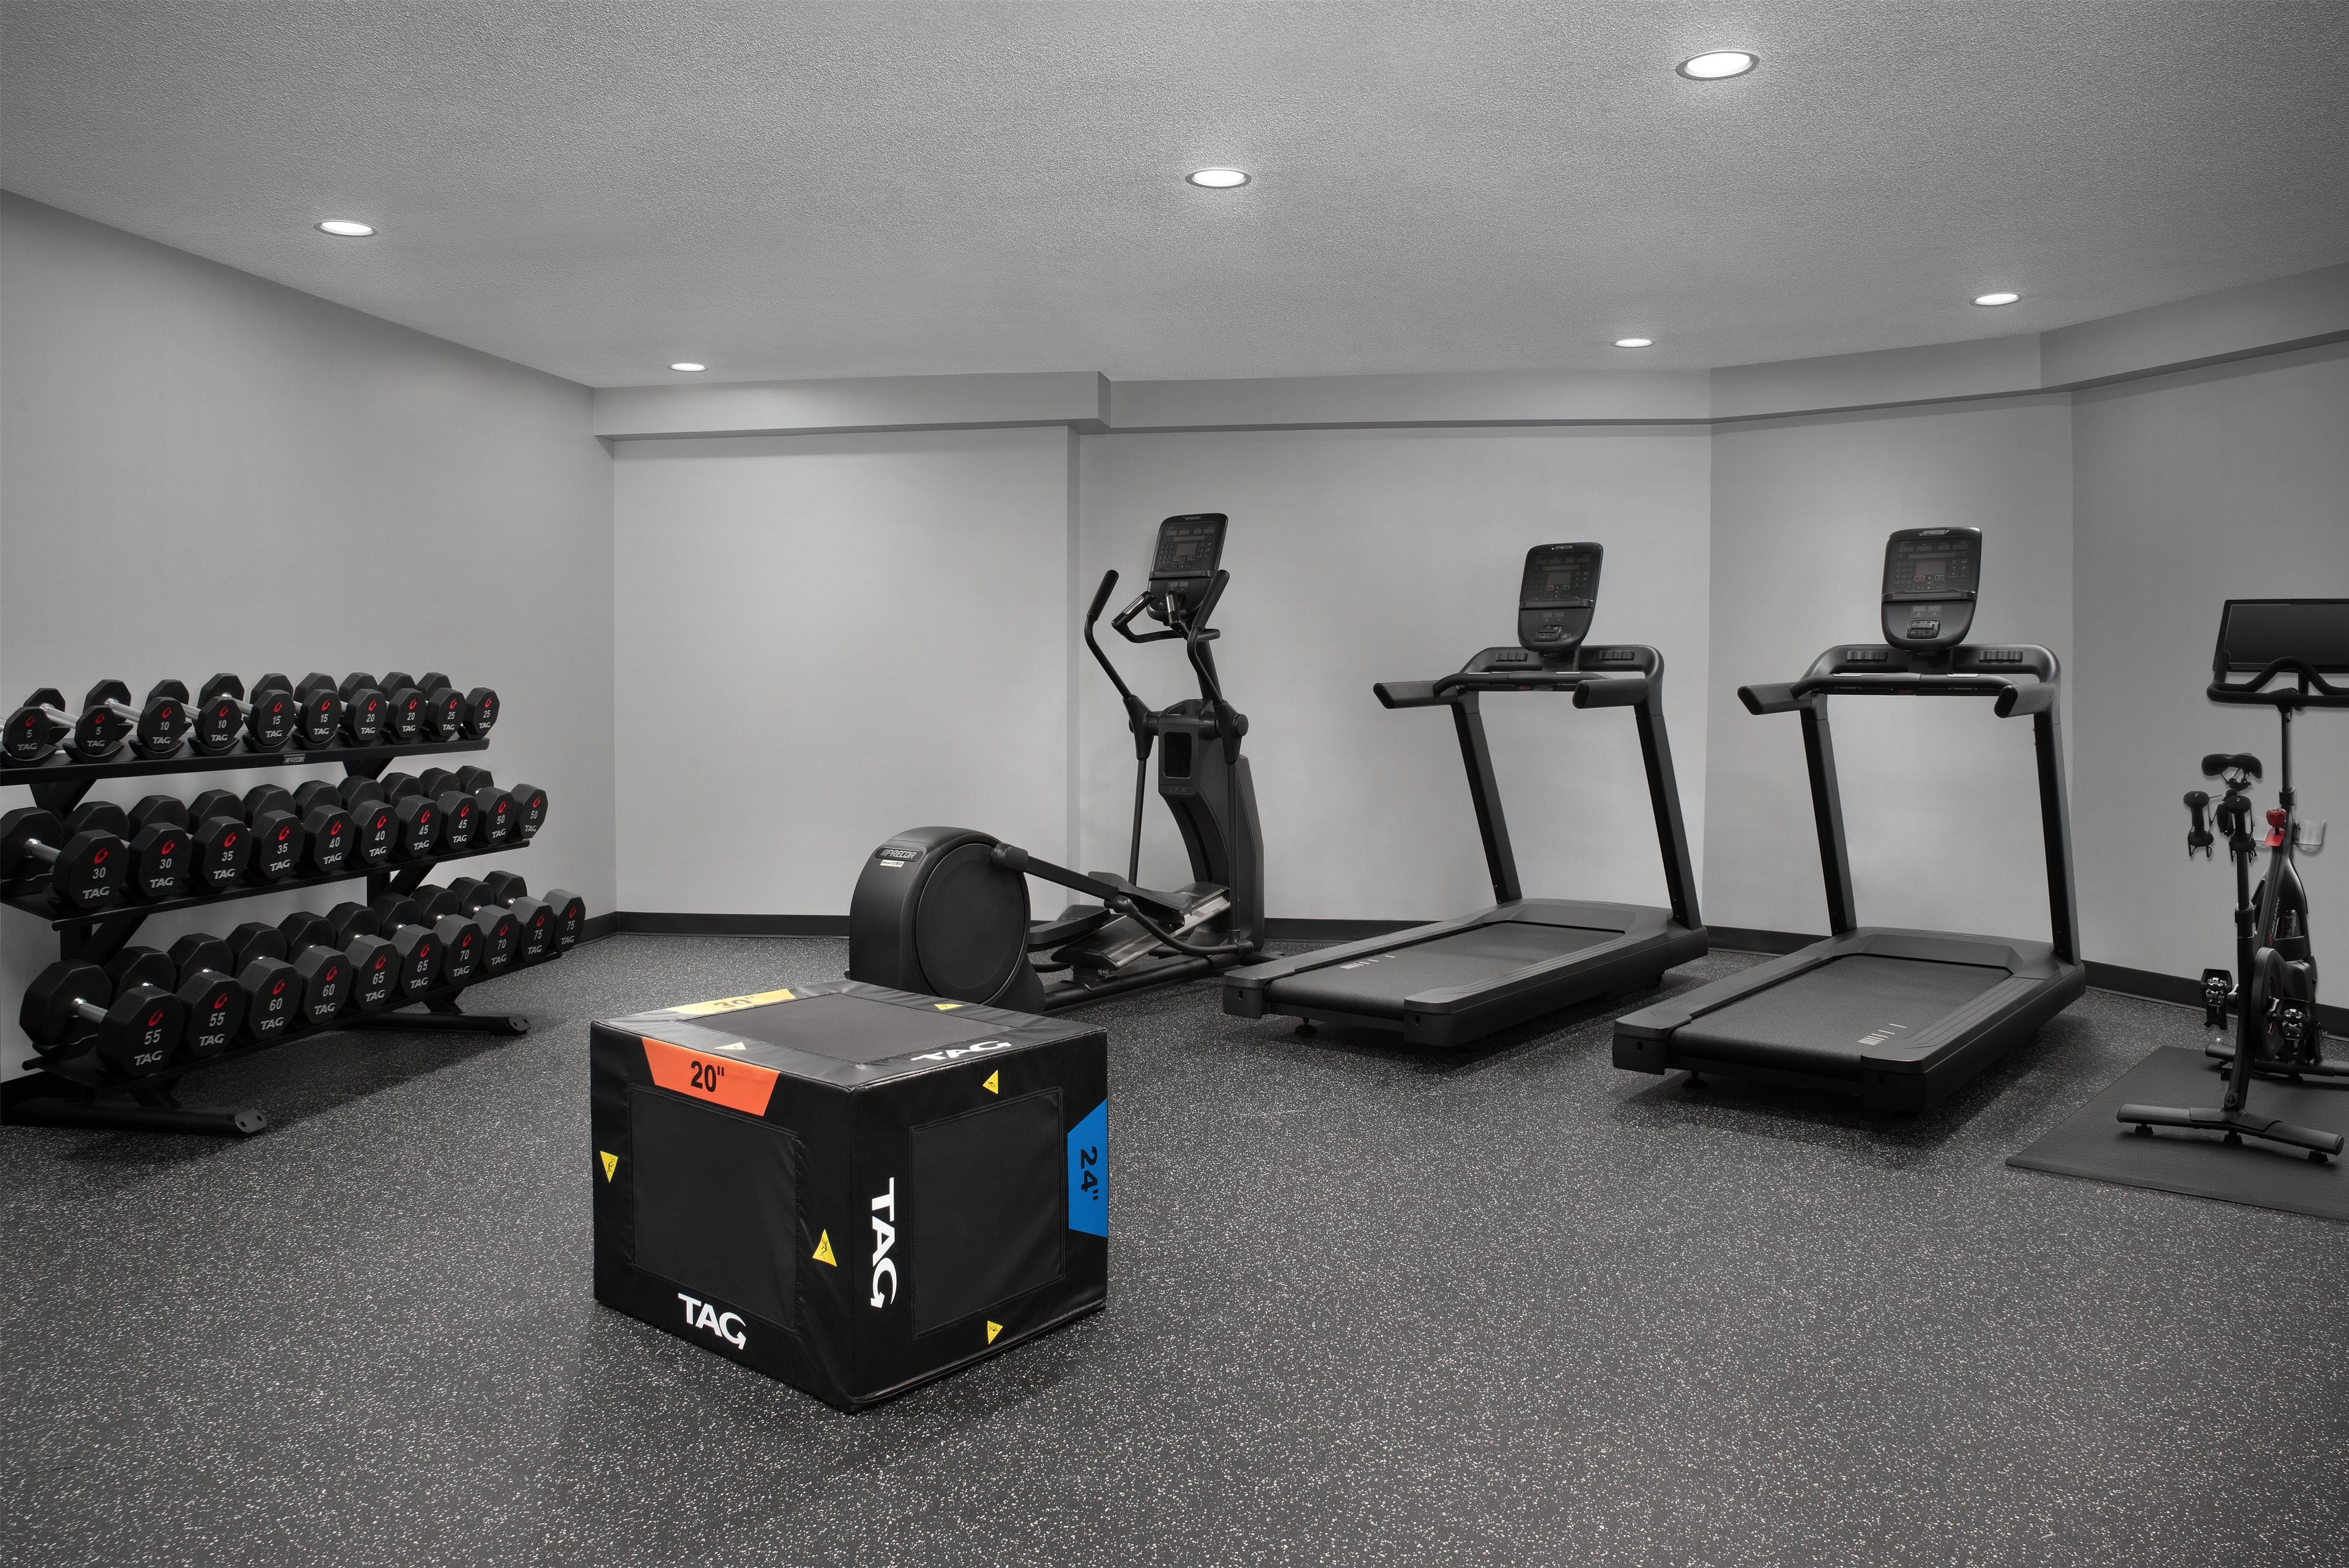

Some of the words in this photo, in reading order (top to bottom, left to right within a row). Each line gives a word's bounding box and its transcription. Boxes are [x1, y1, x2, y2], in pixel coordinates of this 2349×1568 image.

[321, 713, 329, 723] 15
[366, 713, 375, 723] 20
[407, 712, 416, 721] 20
[447, 712, 456, 720] 25
[483, 710, 491, 718] 25
[160, 721, 170, 730] 10
[218, 719, 227, 729] 10
[272, 715, 281, 725] 15
[478, 721, 492, 730] TAG
[26, 729, 33, 738] 5
[95, 726, 102, 735] 5
[496, 814, 505, 825] 50
[530, 810, 538, 819] 50
[458, 819, 468, 829] 45
[524, 825, 538, 833] TAG
[374, 830, 385, 841] 40
[418, 825, 429, 836] 45
[491, 828, 507, 839] TAG
[328, 836, 341, 849] 40
[453, 834, 467, 843] TAG
[277, 842, 289, 854] 35
[413, 840, 430, 850] TAG
[221, 850, 234, 861] 35
[369, 846, 387, 857] TAG
[885, 849, 917, 859] PRECOR
[159, 858, 173, 869] 30
[323, 852, 343, 864] TAG
[270, 859, 291, 872] TAG
[92, 867, 106, 879] 30
[213, 868, 236, 880] TAG
[149, 877, 174, 888] TAG
[82, 886, 110, 899] TAG
[566, 920, 576, 931] 75
[533, 929, 543, 940] 75
[560, 935, 576, 945] TAG
[497, 938, 507, 950] 70
[459, 949, 470, 961] 70
[527, 945, 543, 955] TAG
[491, 954, 507, 965] TAG
[417, 959, 429, 972] 65
[453, 965, 470, 977] TAG
[373, 972, 385, 985] 65
[410, 977, 429, 989] TAG
[322, 983, 335, 997] 60
[365, 989, 385, 1002] TAG
[269, 997, 283, 1011] 60
[314, 1002, 336, 1015] TAG
[209, 1012, 226, 1027] 55
[260, 1017, 284, 1030] TAG
[144, 1029, 161, 1045] 55
[199, 1033, 225, 1047] TAG
[910, 1040, 1012, 1061] TAG
[134, 1050, 163, 1066] TAG
[690, 1060, 725, 1093] 20"
[1080, 1146, 1099, 1201] 24"
[870, 1177, 897, 1309] TAG
[677, 1292, 747, 1351] TAG
